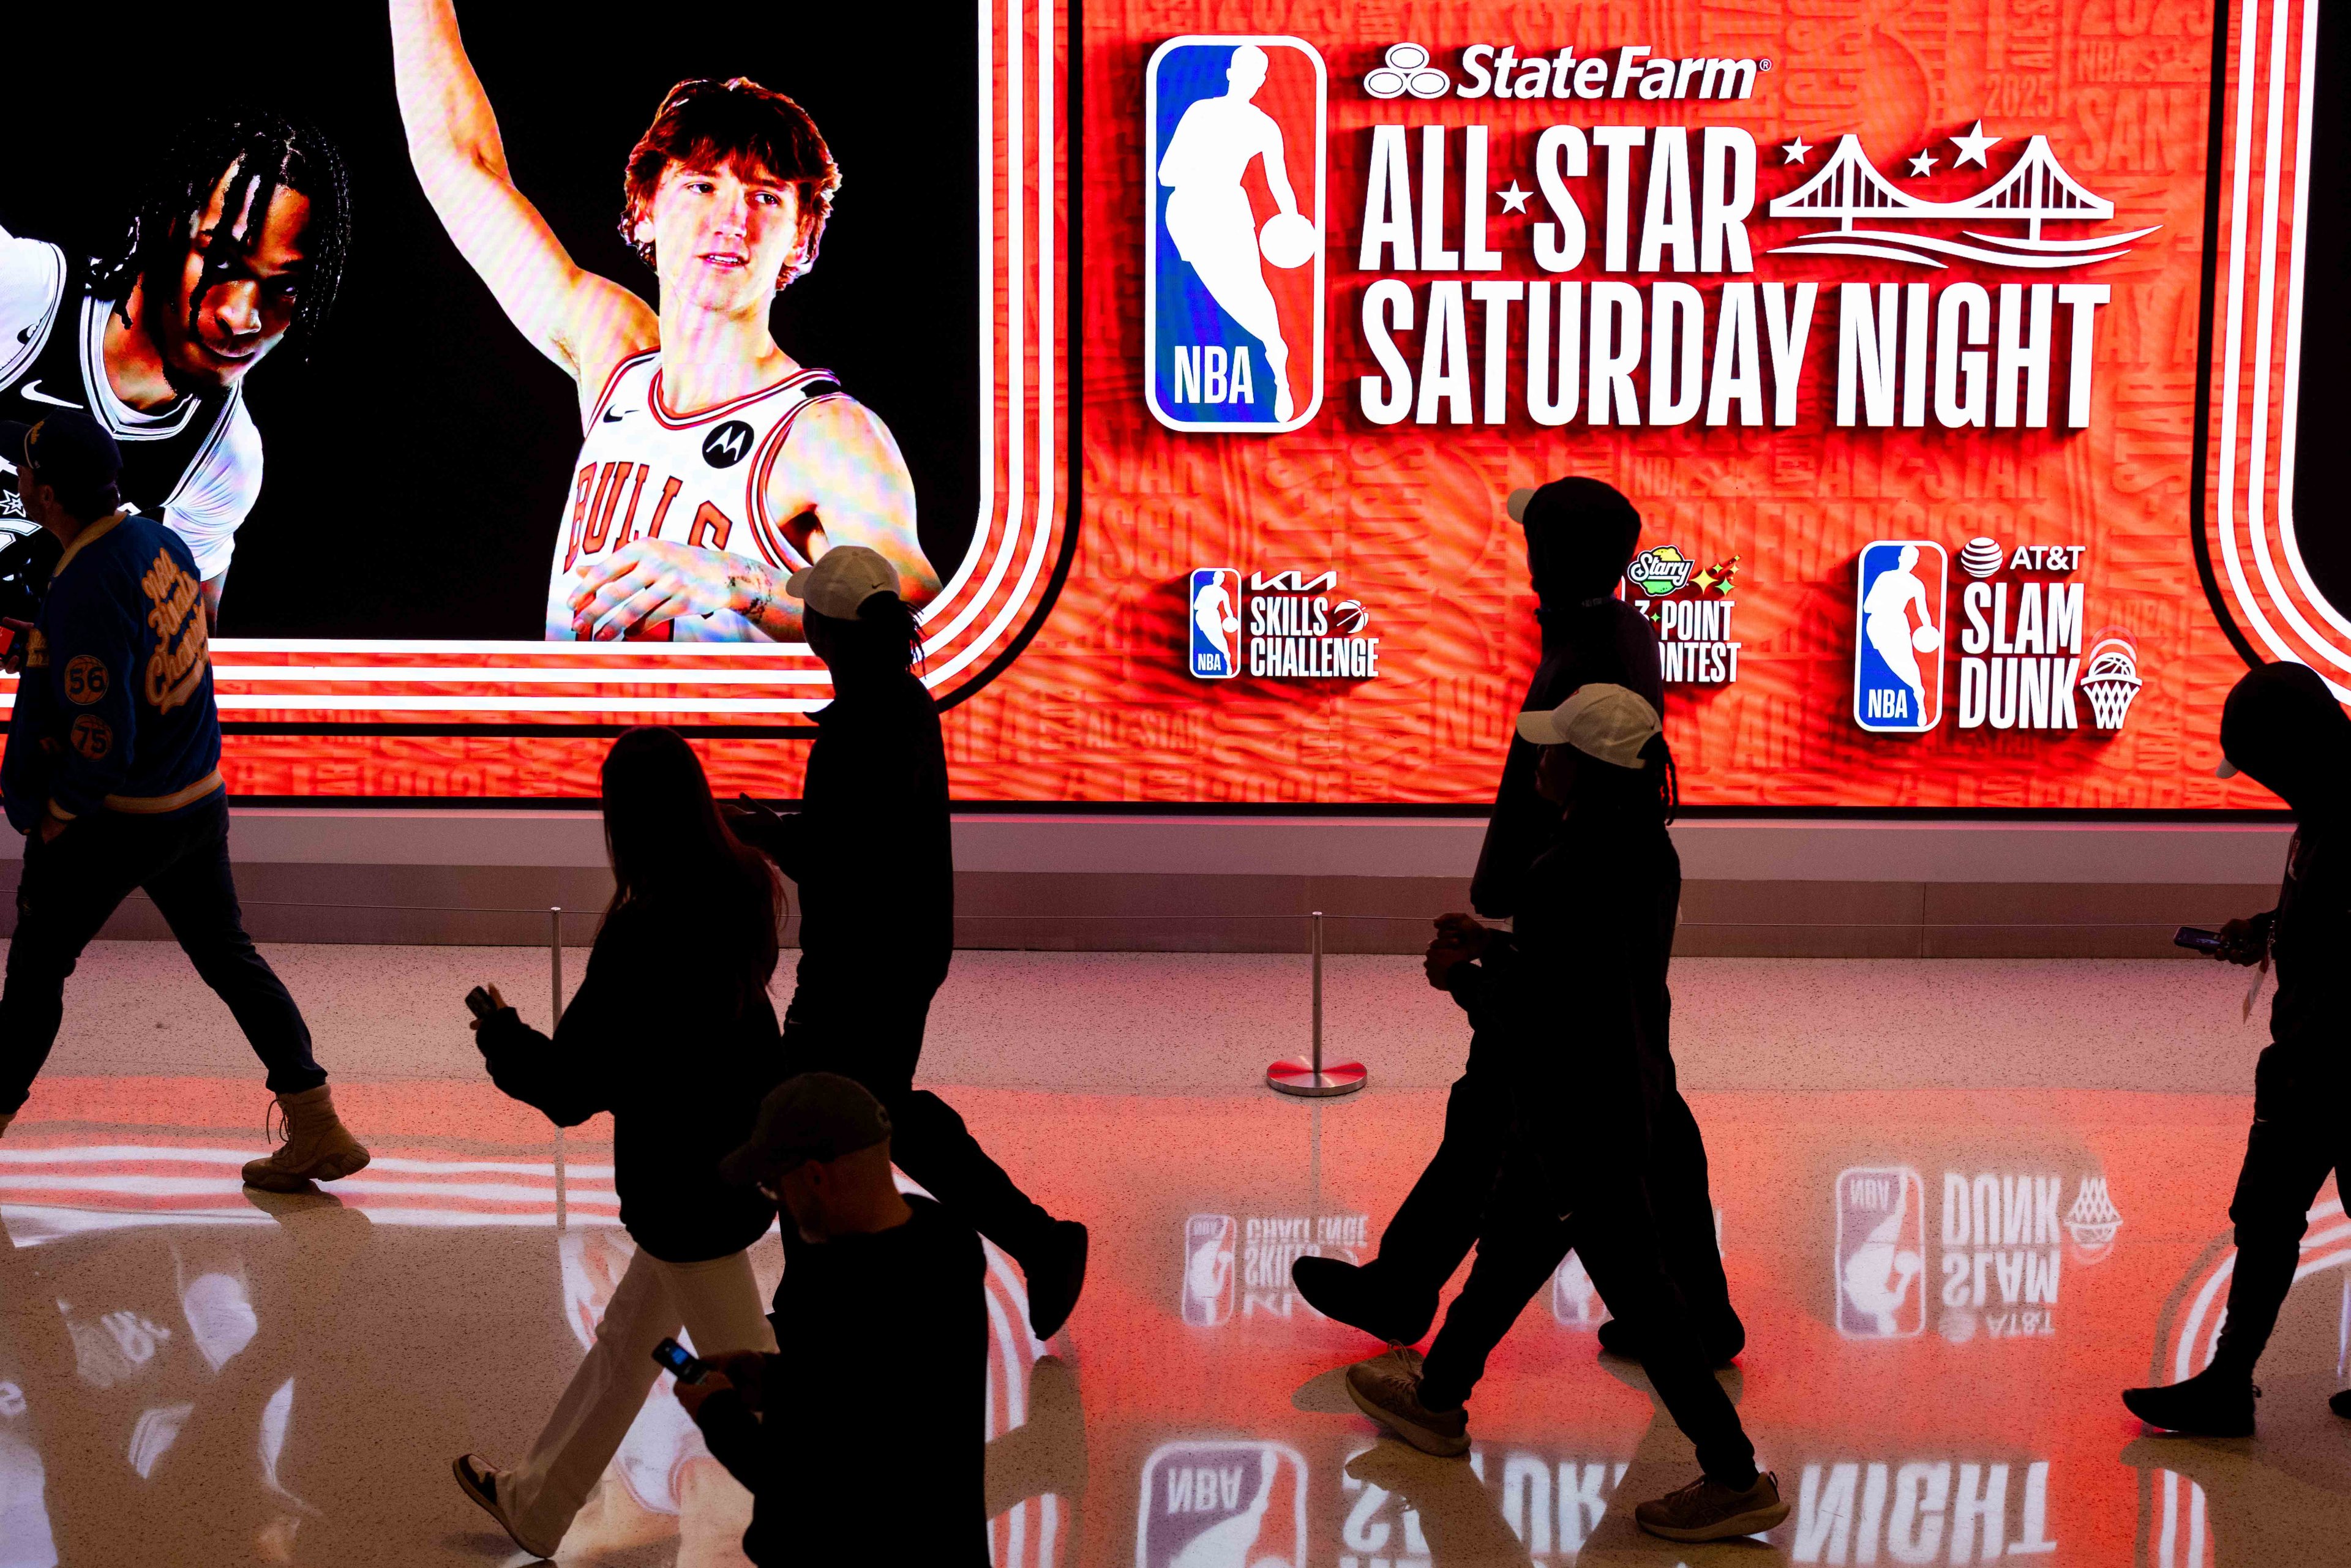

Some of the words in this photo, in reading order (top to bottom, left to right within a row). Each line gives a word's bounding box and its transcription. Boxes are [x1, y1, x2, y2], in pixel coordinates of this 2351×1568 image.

[1361, 279, 1818, 426] SATURDAY
[1837, 282, 2110, 427] NIGHT
[1175, 346, 1254, 403] NBA
[1630, 552, 1692, 588] Starry
[2010, 546, 2085, 570] AT&T
[1251, 571, 1337, 591] KIA
[1251, 597, 1328, 636] SKILLS
[1661, 600, 1735, 641] POINT
[1962, 582, 2084, 654] SLAM
[1197, 654, 1221, 671] NBA
[1251, 637, 1379, 677] CHALLENGE
[1659, 641, 1742, 683] NTEST
[70, 667, 106, 694] 56
[1959, 657, 2078, 729] DUNK
[1868, 689, 1908, 718] NBA
[75, 725, 107, 754] 75
